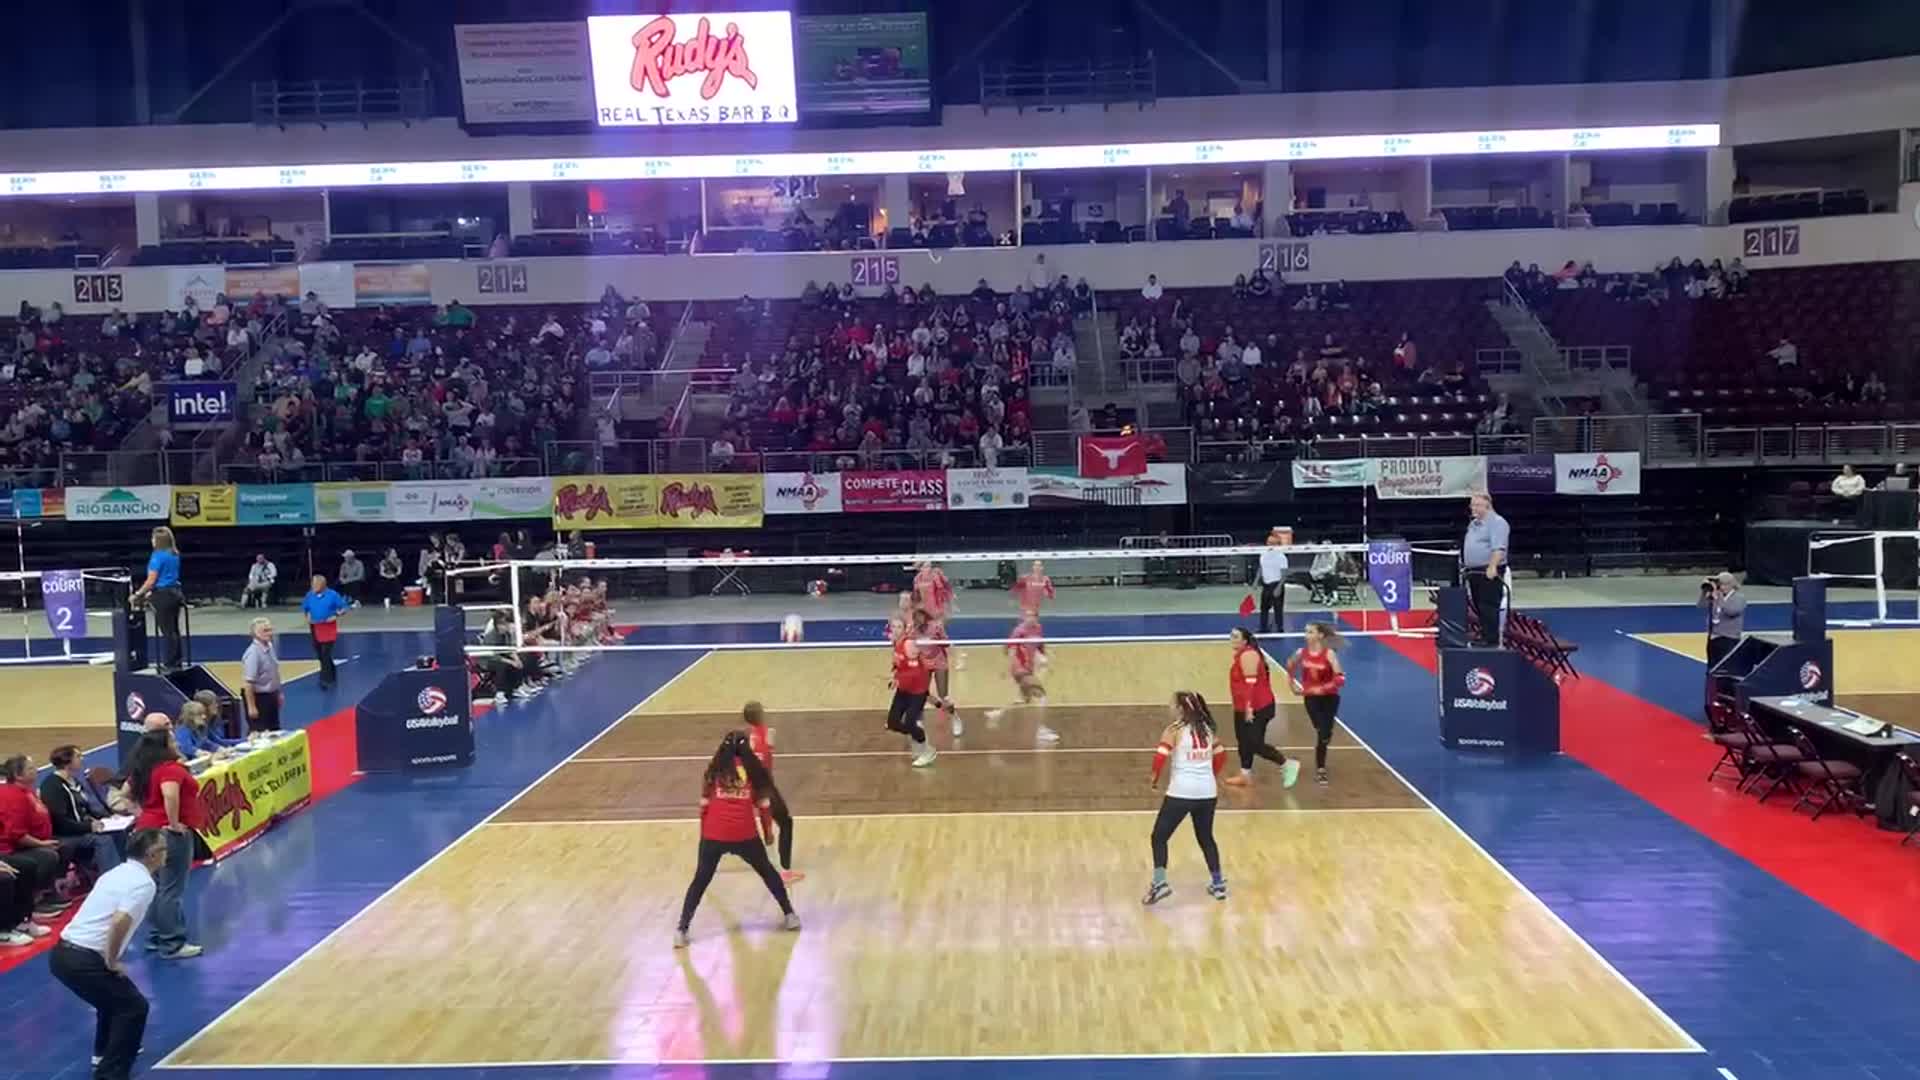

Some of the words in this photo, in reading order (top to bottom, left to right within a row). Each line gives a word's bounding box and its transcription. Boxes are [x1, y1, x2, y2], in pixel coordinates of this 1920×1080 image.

[631, 16, 757, 99] Rudy's
[601, 107, 648, 122] REAL
[652, 106, 709, 125] TEXAS
[719, 106, 754, 121] BAR
[1747, 230, 1799, 254] 217
[1261, 247, 1308, 269] 216
[480, 269, 525, 290] 214
[854, 260, 898, 282] 215
[76, 278, 121, 299] 213
[1381, 459, 1442, 475] PROUDLY
[1568, 467, 1609, 479] NMAA
[776, 486, 814, 497] NMAA
[844, 478, 898, 490] COMPETE
[902, 478, 943, 496] CLASS
[75, 503, 100, 515] RIO
[102, 502, 161, 514] RANCHO
[1369, 550, 1411, 565] COURT
[41, 579, 83, 594] COURT
[1383, 579, 1397, 603] 3
[56, 607, 73, 630] 2
